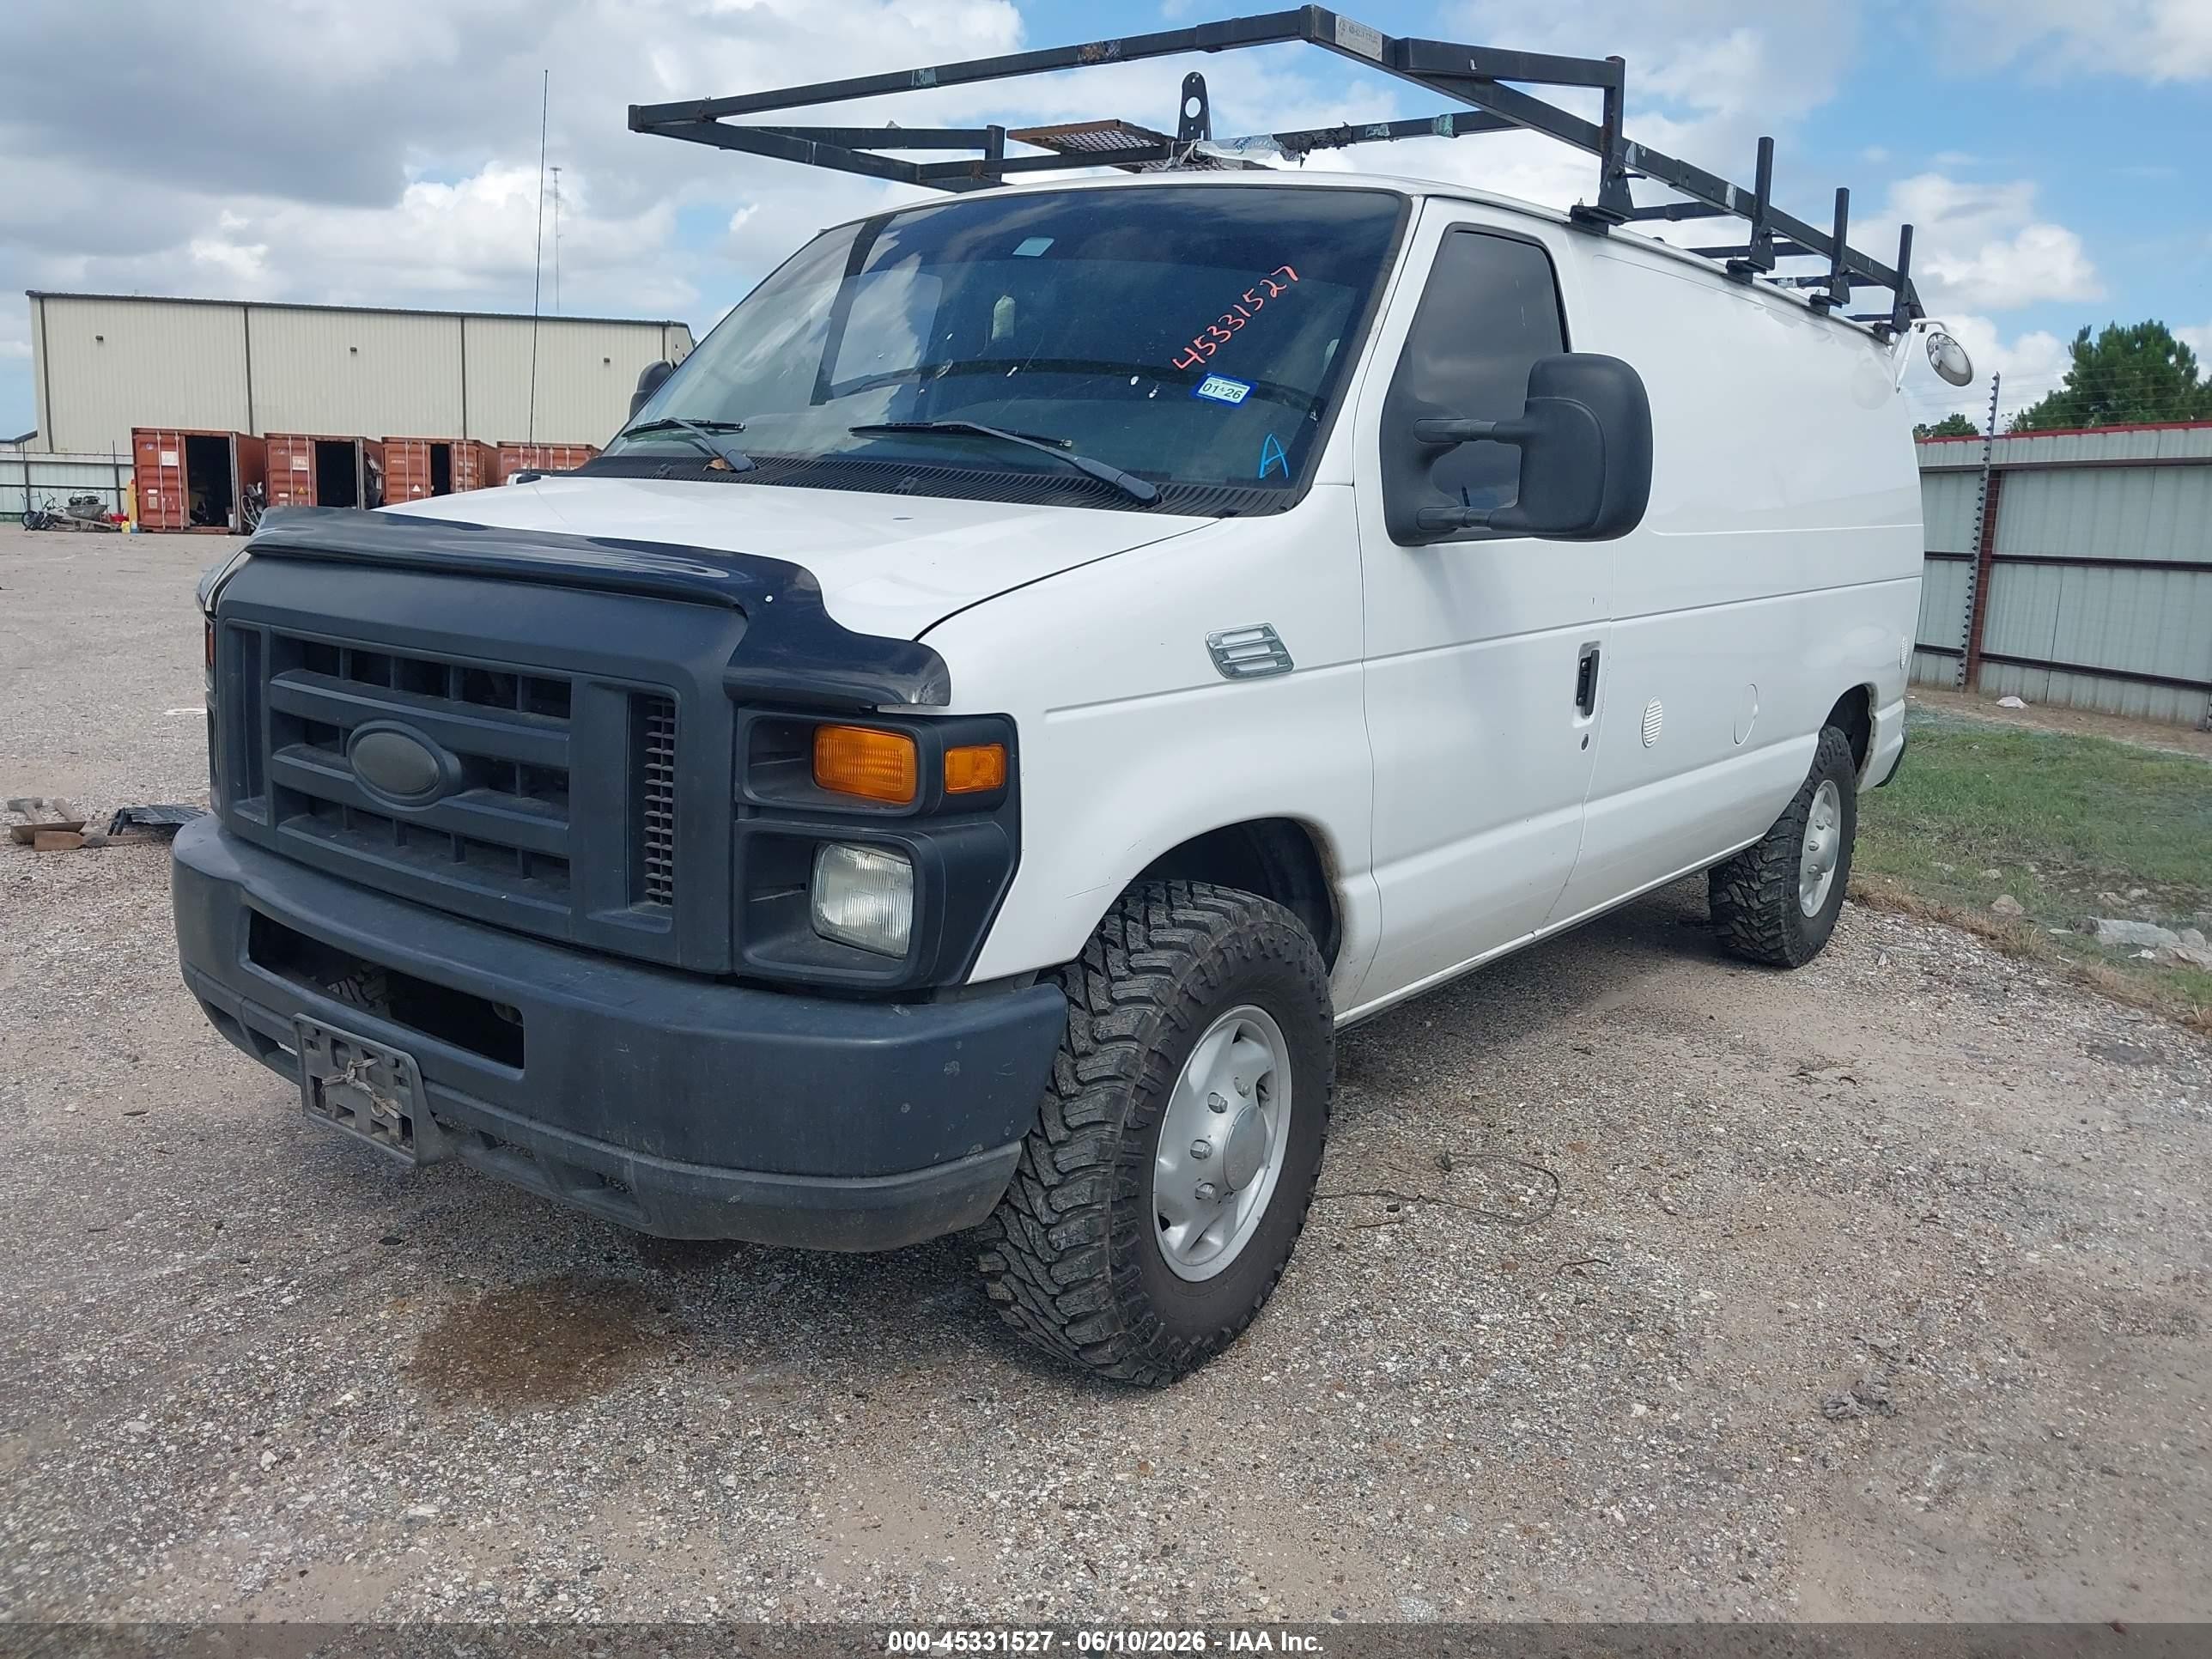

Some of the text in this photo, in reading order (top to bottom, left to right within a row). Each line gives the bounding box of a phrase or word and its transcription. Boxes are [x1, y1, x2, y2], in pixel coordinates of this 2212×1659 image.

[1171, 264, 1299, 370] 45331527
[1202, 383, 1219, 394] 01
[1224, 388, 1243, 399] 26
[1258, 433, 1289, 480] A
